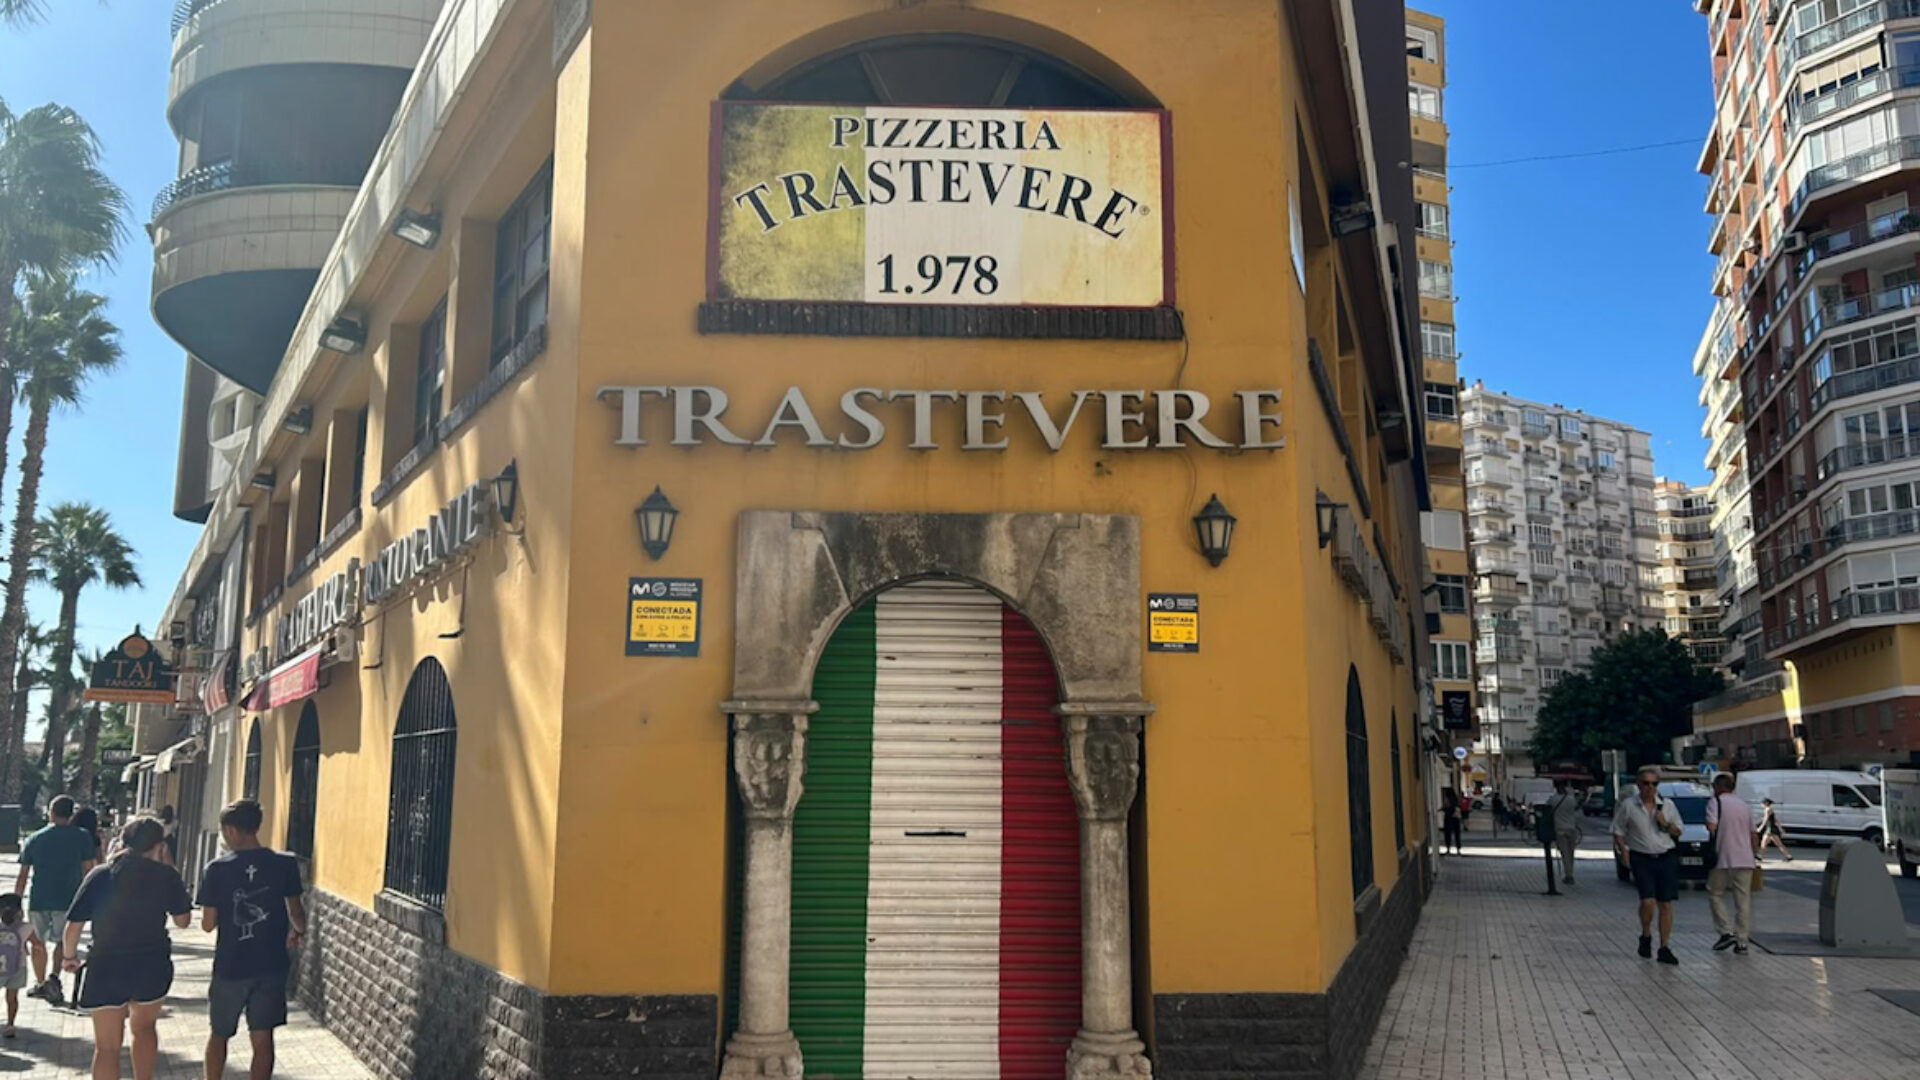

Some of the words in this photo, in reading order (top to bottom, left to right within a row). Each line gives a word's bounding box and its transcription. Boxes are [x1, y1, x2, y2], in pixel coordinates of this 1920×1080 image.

[833, 116, 1061, 151] PIZZERIA
[735, 159, 1138, 239] TRASTEVERE
[877, 254, 1000, 295] 1.978
[596, 385, 1286, 452] TRASTEVERE
[112, 659, 154, 680] TAJ
